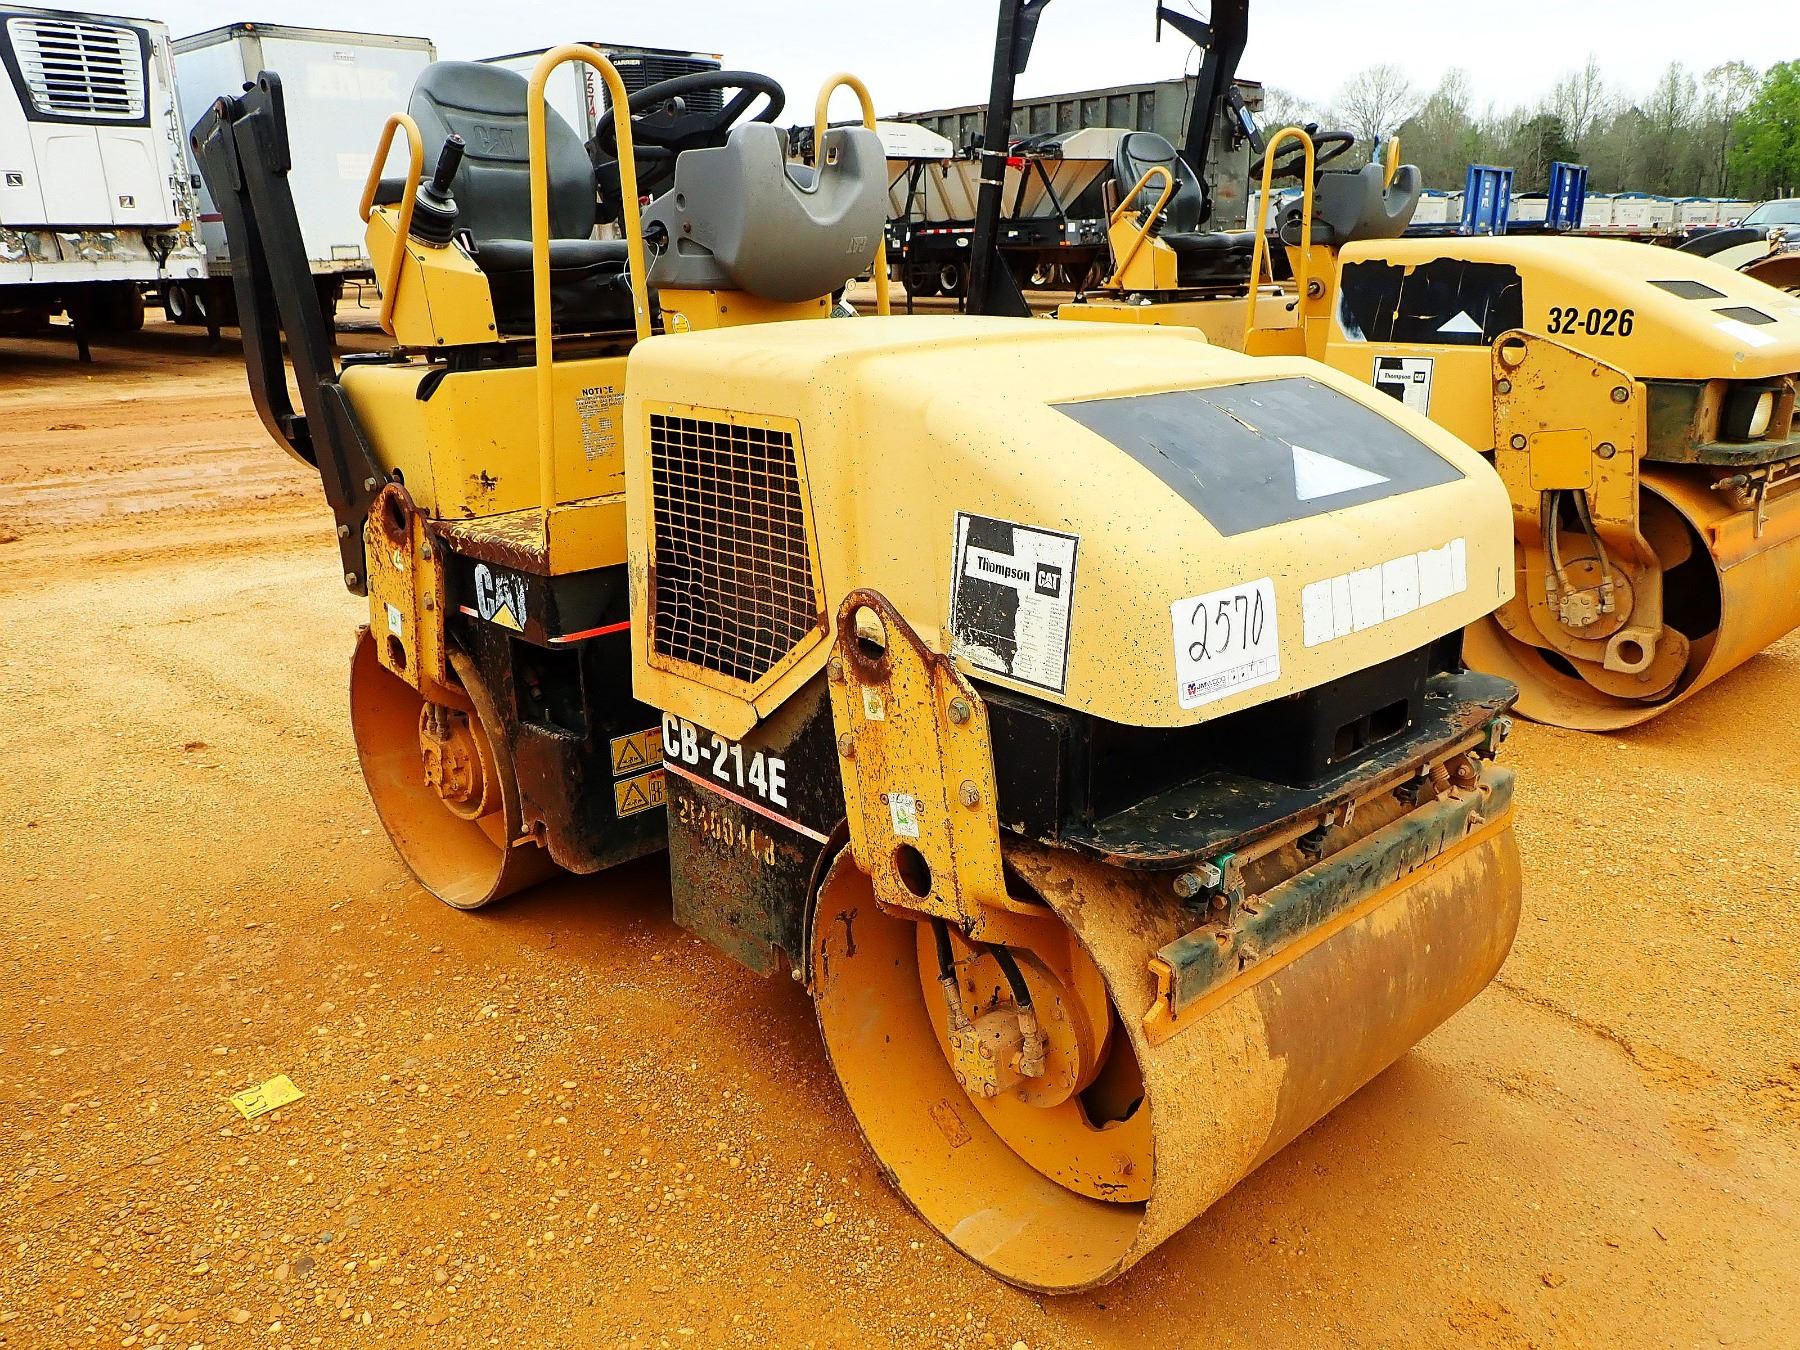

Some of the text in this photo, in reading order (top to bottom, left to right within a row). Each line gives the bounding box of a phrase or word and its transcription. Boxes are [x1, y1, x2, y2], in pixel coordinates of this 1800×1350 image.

[1547, 307, 1635, 337] 32-026
[977, 555, 1061, 590] Thompson CAT
[1189, 588, 1264, 662] 2570
[662, 711, 788, 808] CB-214E
